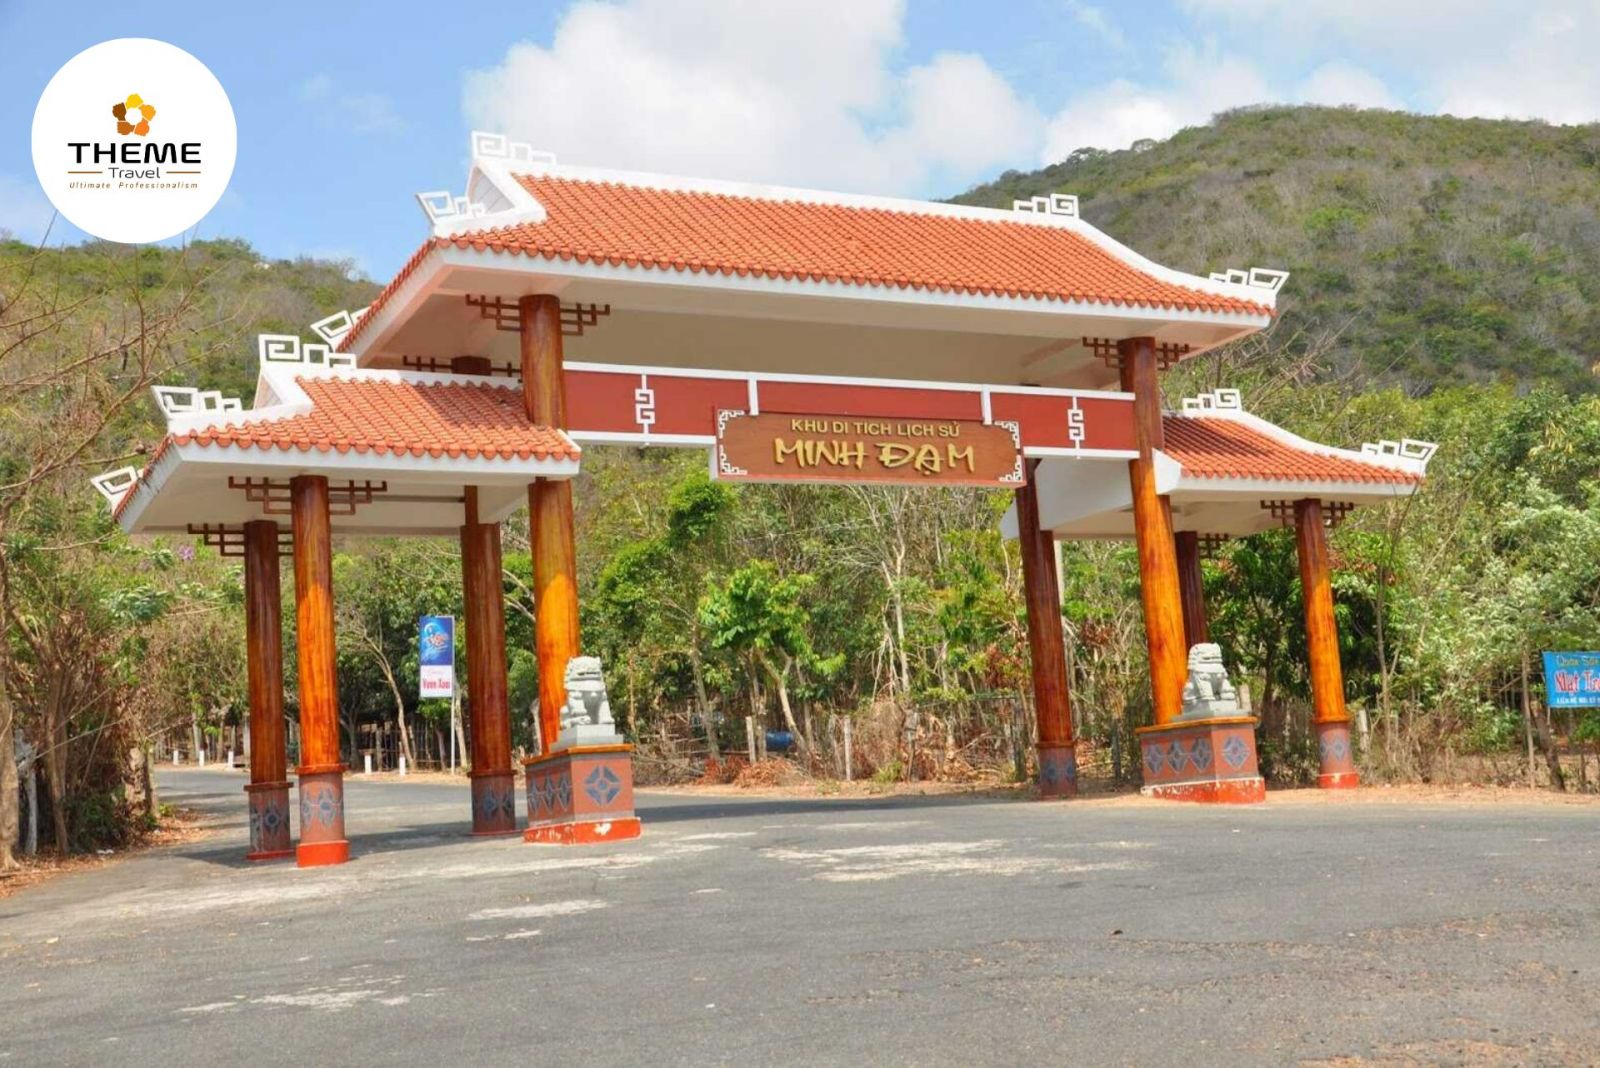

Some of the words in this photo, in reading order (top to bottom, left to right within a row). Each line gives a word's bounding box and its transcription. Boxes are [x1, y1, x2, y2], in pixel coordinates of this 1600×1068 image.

[791, 418, 828, 433] KHU
[832, 421, 849, 434] DI
[774, 437, 869, 470] MINH
[873, 443, 975, 476] ĐẠM
